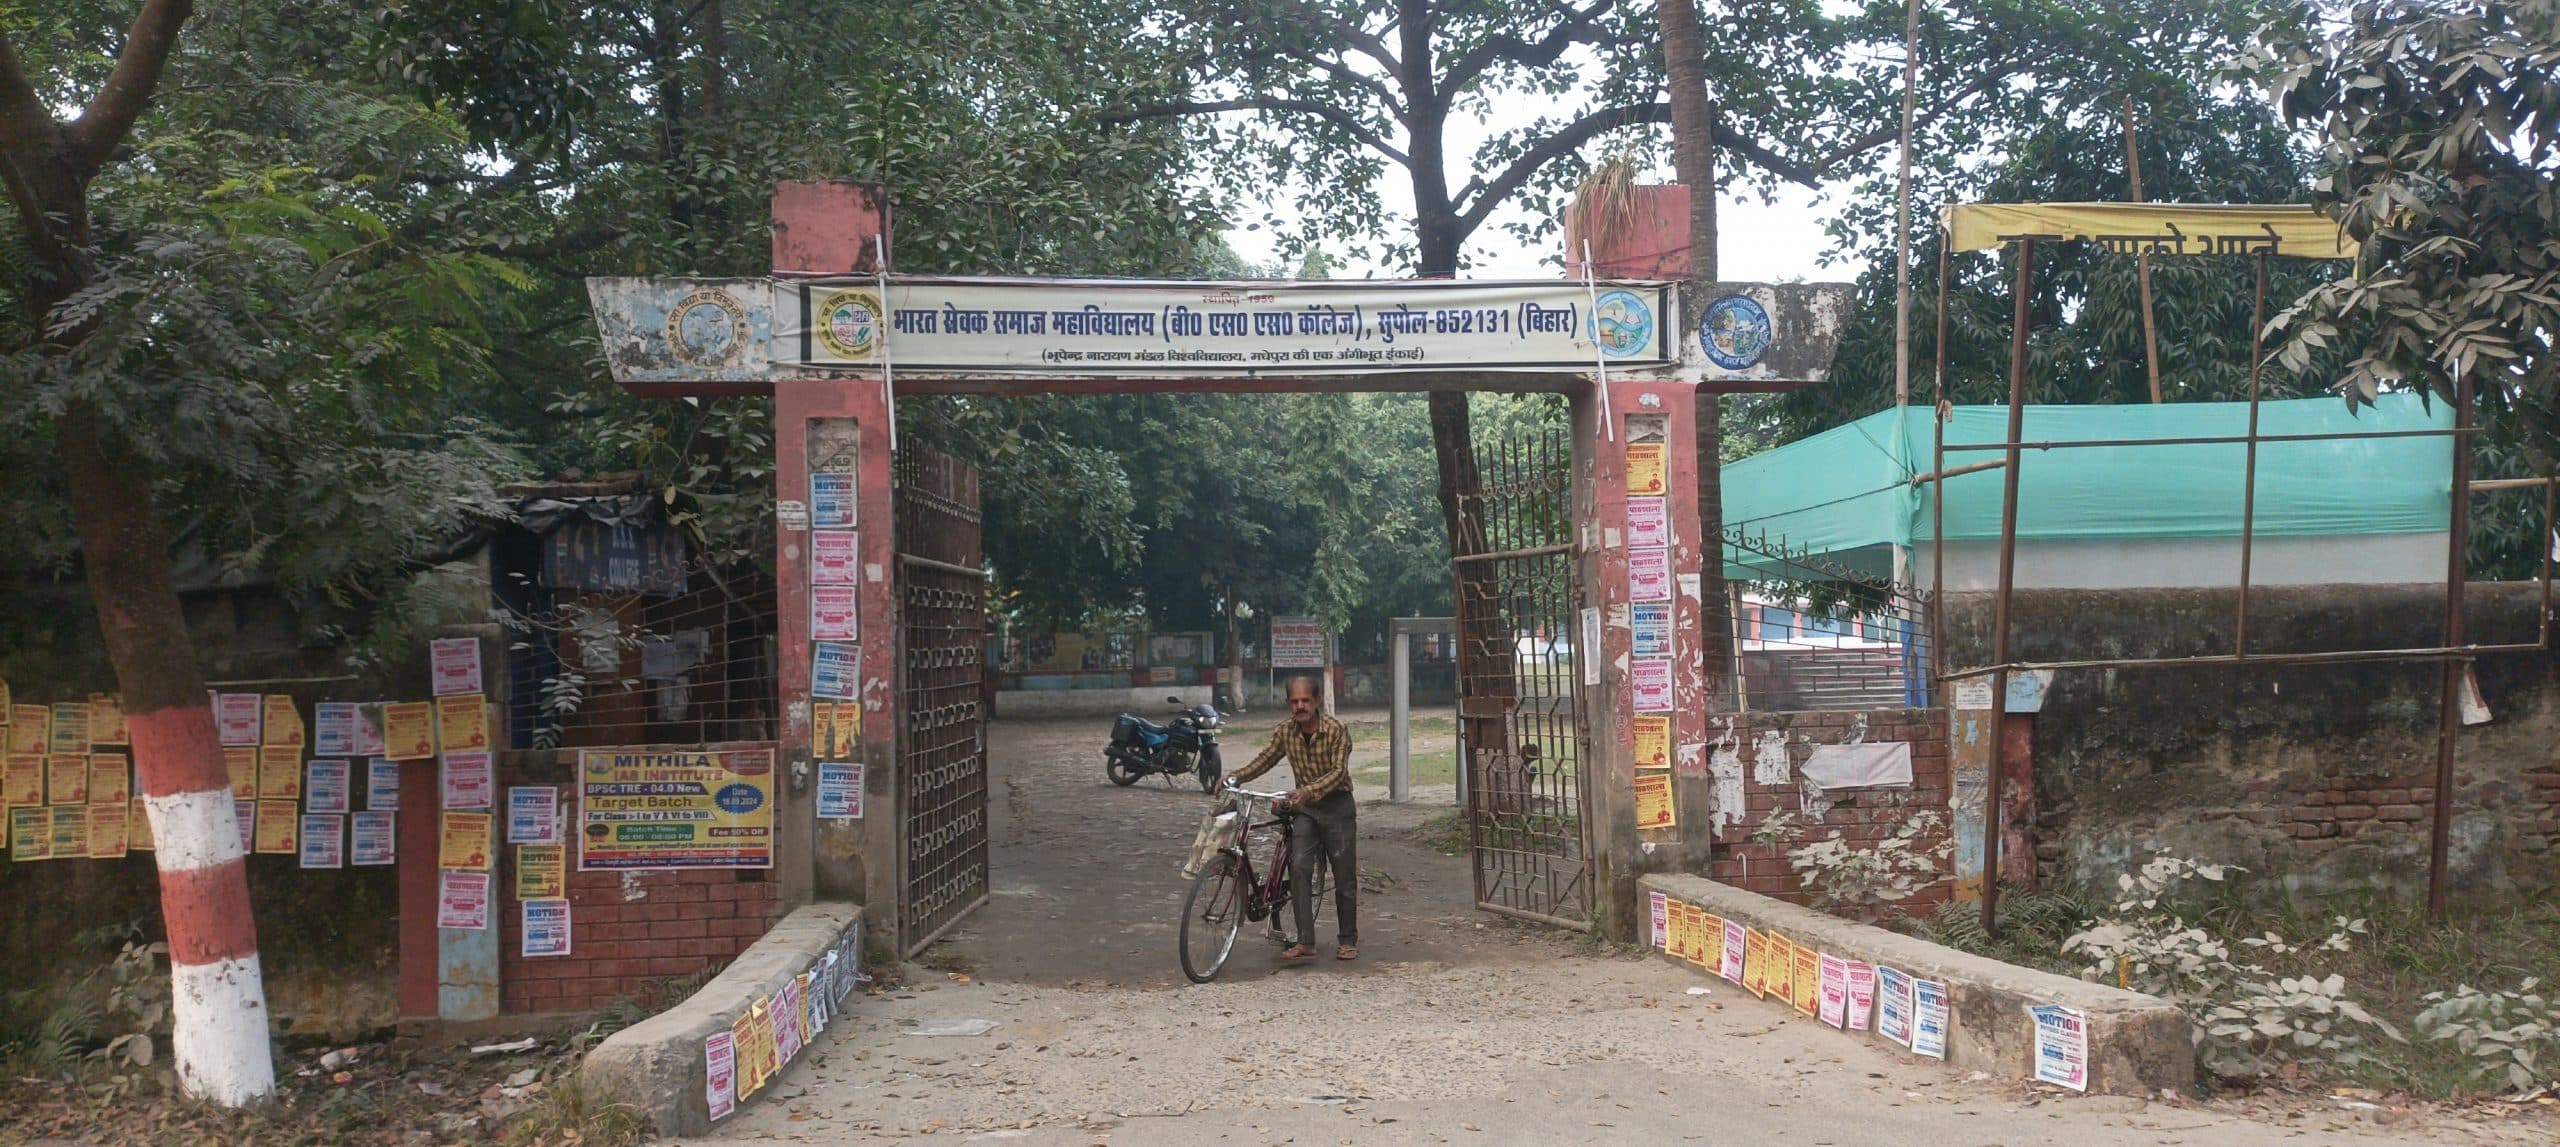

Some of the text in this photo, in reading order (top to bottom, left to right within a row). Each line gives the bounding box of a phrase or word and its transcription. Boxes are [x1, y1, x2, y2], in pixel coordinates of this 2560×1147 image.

[894, 309, 938, 334] भारत
[942, 301, 989, 334] सेवक
[993, 310, 1047, 335] समाज
[1052, 304, 1155, 336] महाविद्यालय
[1377, 303, 1509, 343] सुपौल-852131
[1517, 302, 1578, 339] (बिहार)
[1041, 348, 1083, 364] (भूपेन्द्र
[1086, 351, 1131, 361] नारायण
[1134, 349, 1164, 362] मंडल
[1250, 349, 1289, 363] मधेपुरा
[1293, 348, 1309, 361] की
[1313, 352, 1333, 361] एक
[1337, 347, 1382, 362] अंगीभूत
[815, 482, 852, 490] MOTION
[1635, 612, 1668, 620] MOTION
[818, 651, 856, 662] MOTION
[614, 755, 711, 767] MITHILA
[645, 769, 723, 781] INSTITUTE
[823, 771, 859, 780] MOTION
[587, 783, 617, 794] BPSC
[619, 784, 641, 793] TRE
[650, 784, 674, 793] 04.0
[676, 784, 701, 794] New
[731, 787, 748, 796] Date
[592, 797, 692, 810] Target Batch
[604, 812, 626, 820] Class
[643, 812, 652, 820] to
[731, 828, 749, 836] 50%
[527, 908, 566, 917] MOTION
[1883, 975, 1909, 997] MOTION
[1920, 990, 1950, 1008] MOTION
[2036, 1013, 2081, 1032] MOTION
